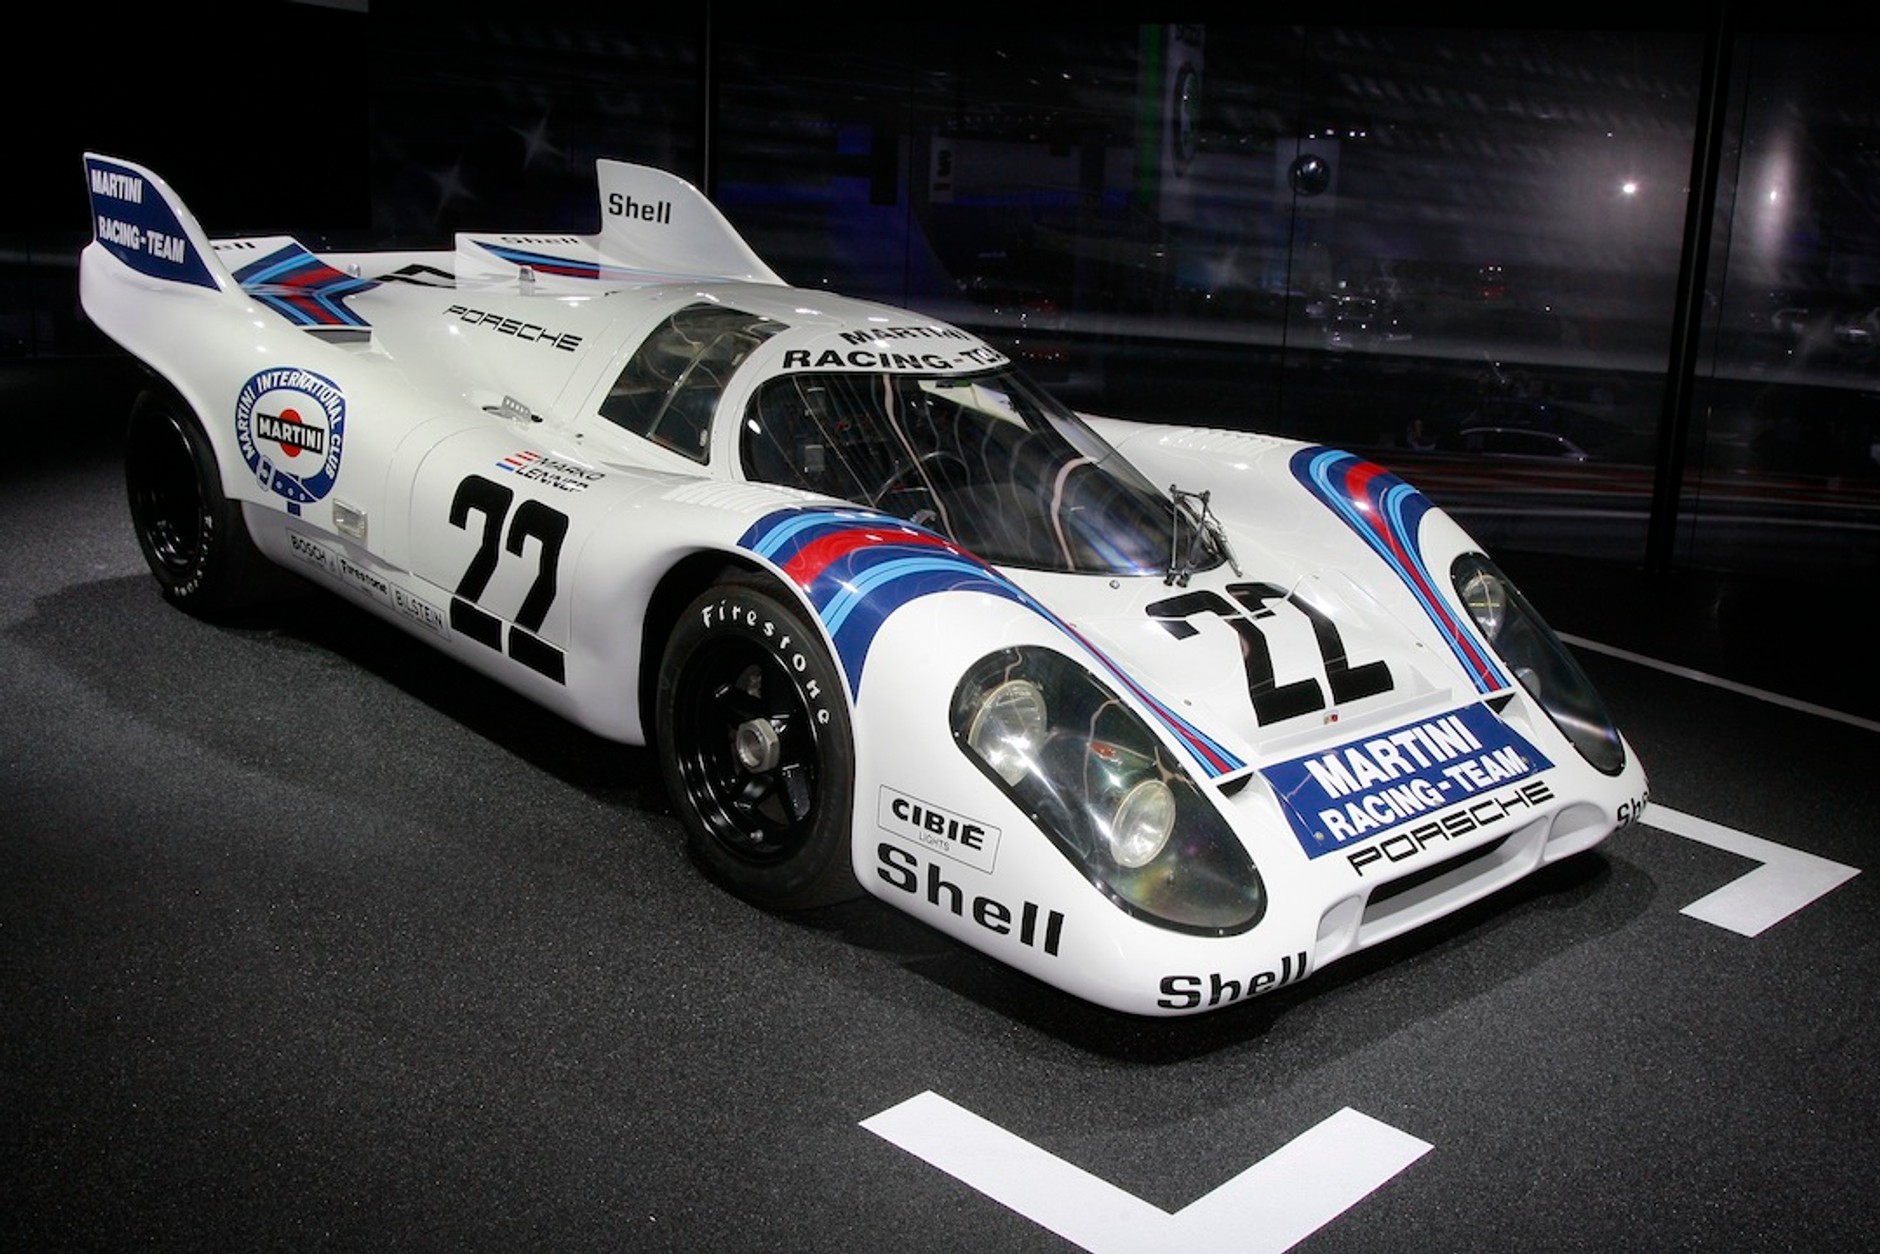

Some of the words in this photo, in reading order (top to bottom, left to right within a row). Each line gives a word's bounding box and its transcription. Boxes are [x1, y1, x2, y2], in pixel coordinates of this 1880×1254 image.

[91, 168, 143, 204] MARTINI
[608, 192, 671, 225] Shell
[98, 214, 186, 264] RACING-TEAM
[442, 304, 583, 352] PORSCHE
[838, 326, 970, 345] MARTINI
[236, 386, 257, 461] MARTINI
[256, 370, 346, 430] INTERNATIONAL
[325, 434, 341, 480] CLUB
[258, 416, 323, 451] MARTINI
[290, 534, 327, 564] BOSCH
[448, 474, 570, 687] 22
[395, 590, 444, 628] BILSTEIN
[701, 600, 830, 724] Firestone
[1144, 581, 1395, 728] 22
[1303, 715, 1483, 799] MARTINI
[1318, 745, 1530, 842] RACING-TEAM
[918, 831, 950, 852] LIGHTS
[1346, 780, 1556, 877] PORSCHE
[877, 842, 1065, 957] Shell
[1157, 951, 1307, 1009] Shell
